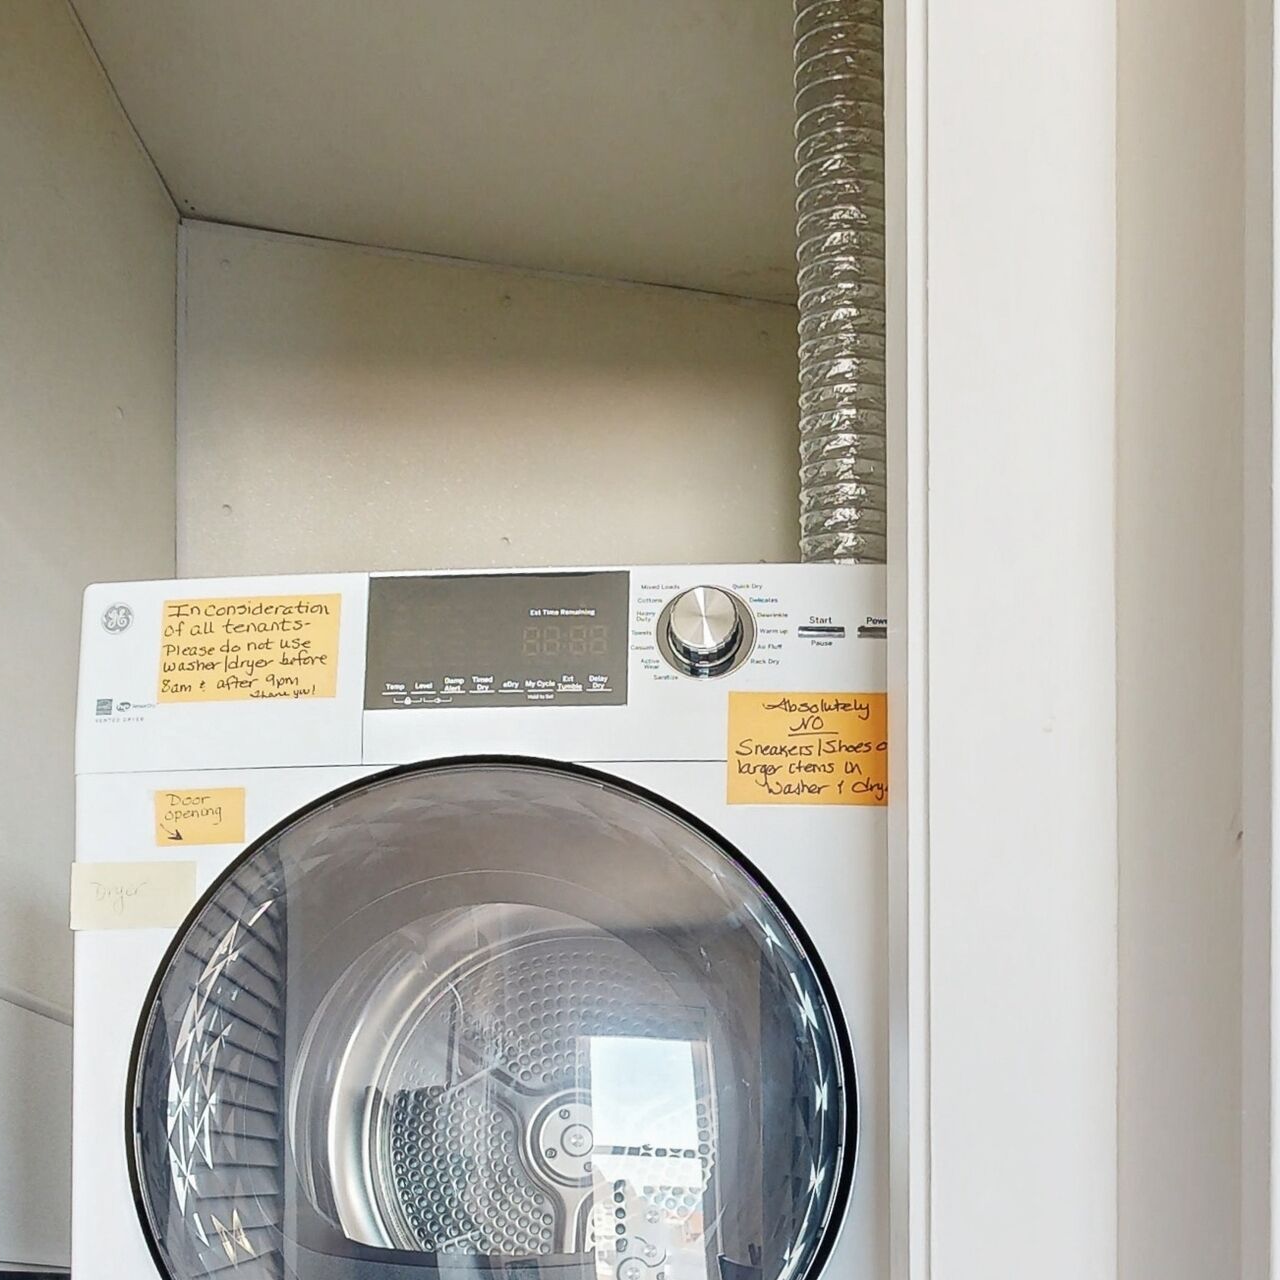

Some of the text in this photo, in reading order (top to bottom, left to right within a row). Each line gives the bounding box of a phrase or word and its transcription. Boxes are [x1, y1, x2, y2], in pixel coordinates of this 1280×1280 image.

[168, 604, 200, 617] In
[542, 608, 559, 616] Time
[560, 607, 596, 617] Remaining
[809, 616, 832, 625] Start
[190, 621, 214, 636] all
[162, 638, 311, 657] Please do not use
[811, 639, 832, 647] Pause
[161, 679, 191, 693] 8am
[217, 675, 258, 690] after
[266, 674, 299, 689] 9pm
[444, 677, 465, 685] Damp
[525, 680, 556, 688] My Cycle
[589, 675, 608, 683] Delay
[385, 683, 405, 691] Temp
[763, 698, 869, 720] Absolutely
[789, 760, 835, 774] items
[844, 762, 862, 775] in
[851, 777, 888, 800] dry
[166, 793, 211, 806] Door
